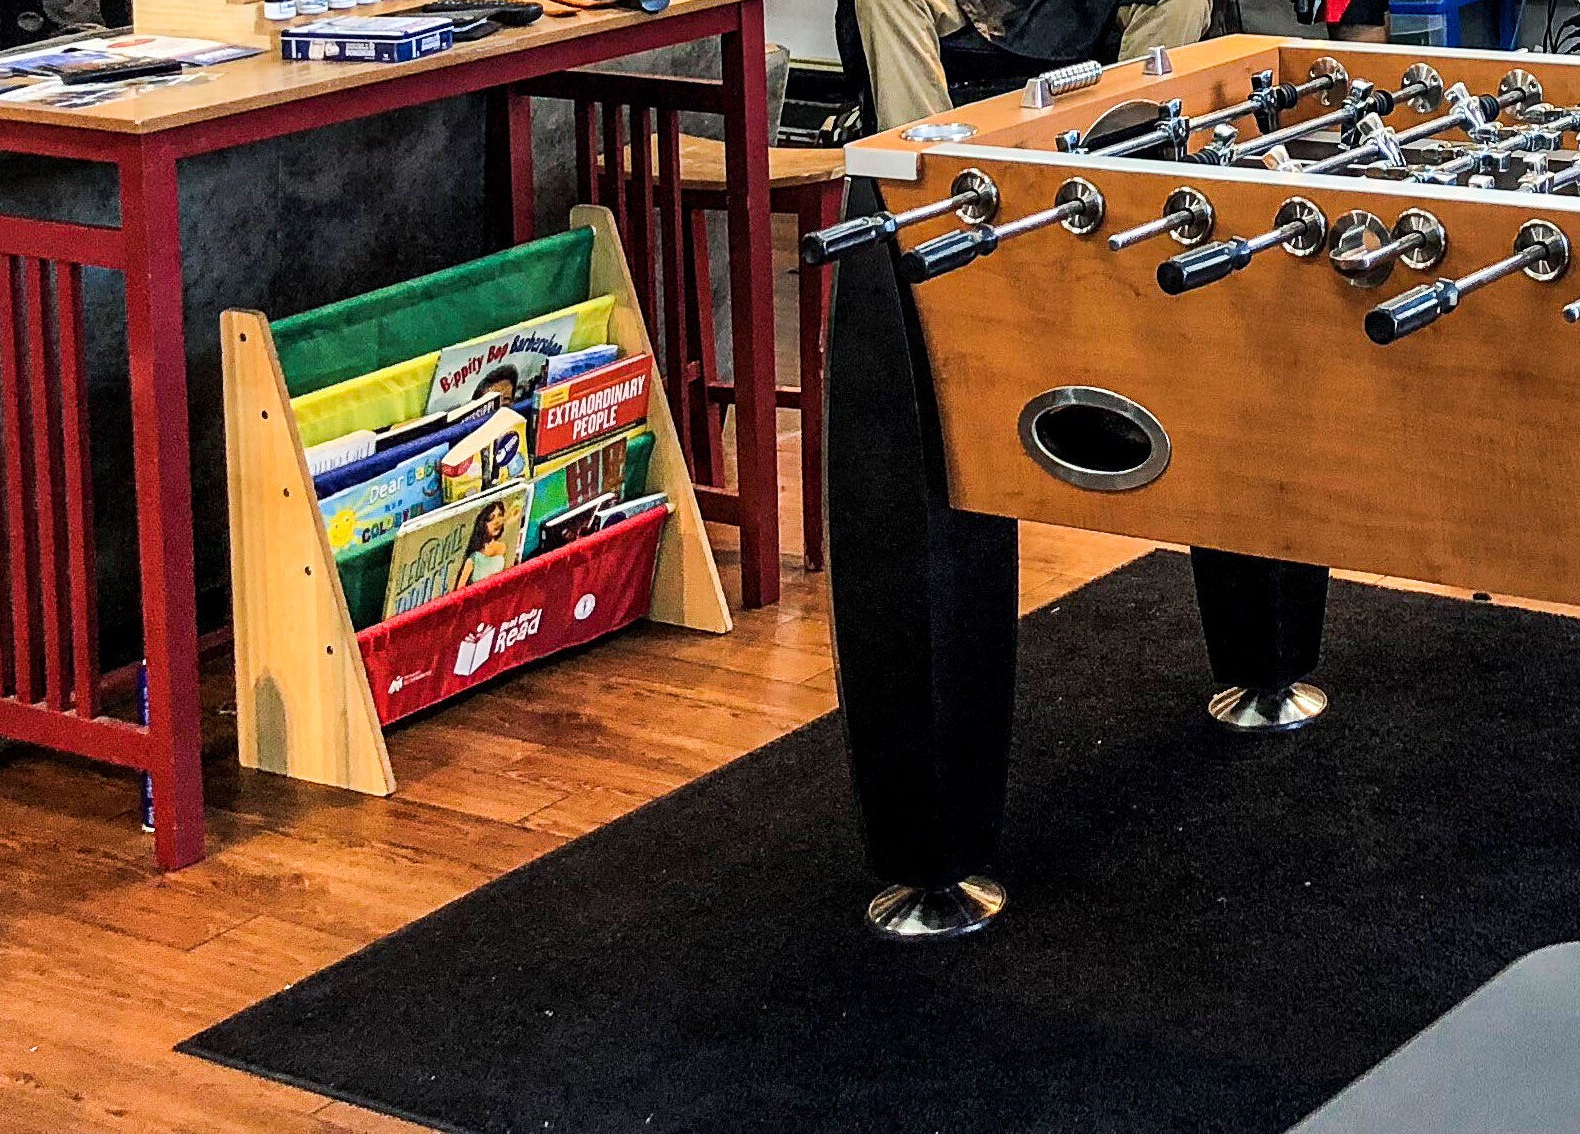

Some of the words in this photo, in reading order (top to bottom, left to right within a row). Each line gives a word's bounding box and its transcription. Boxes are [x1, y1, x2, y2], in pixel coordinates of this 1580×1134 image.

[486, 342, 510, 365] Bop
[546, 374, 646, 430] EXTRAORDINARY
[572, 405, 619, 441] PEOPLE
[367, 476, 405, 505] Dear
[494, 610, 543, 654] Read
